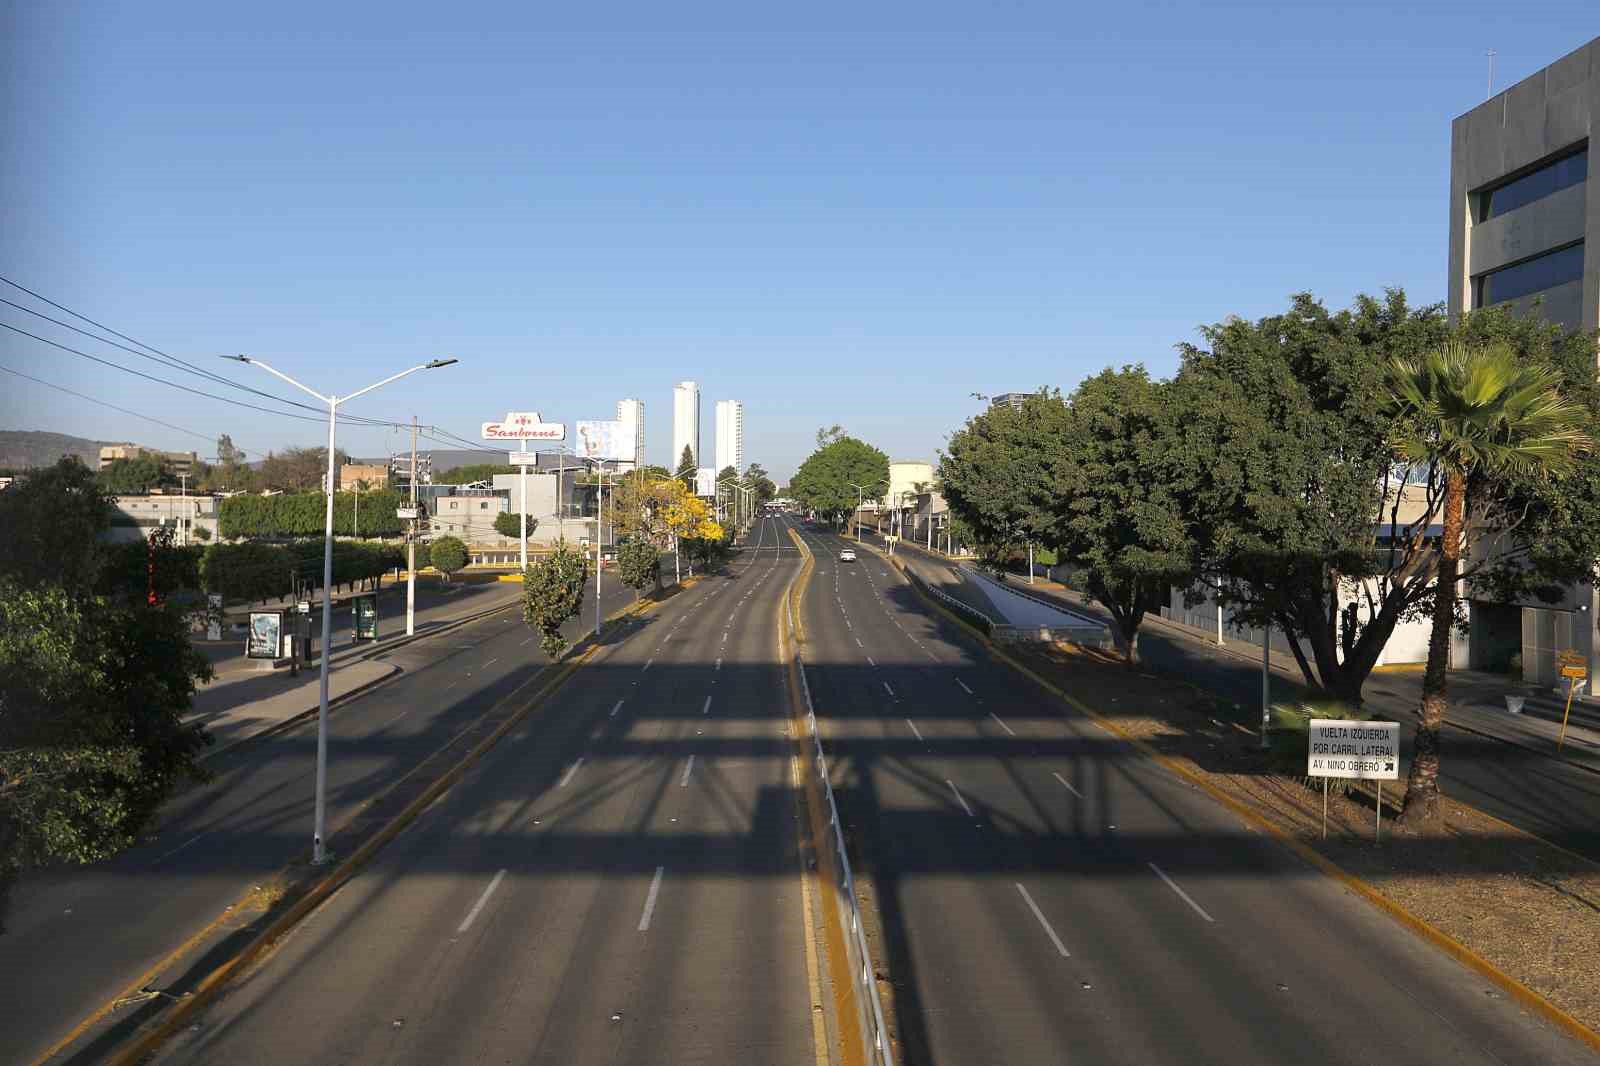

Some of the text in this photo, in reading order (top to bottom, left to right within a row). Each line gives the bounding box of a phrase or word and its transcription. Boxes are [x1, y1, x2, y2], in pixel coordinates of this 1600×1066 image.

[486, 425, 560, 438] Sanborns
[1320, 727, 1390, 740] VUELTA IZQUIERDA
[1313, 743, 1393, 757] POR CARRIL LATERAL
[1313, 759, 1325, 769] AV.
[1348, 761, 1379, 772] OBRERO
